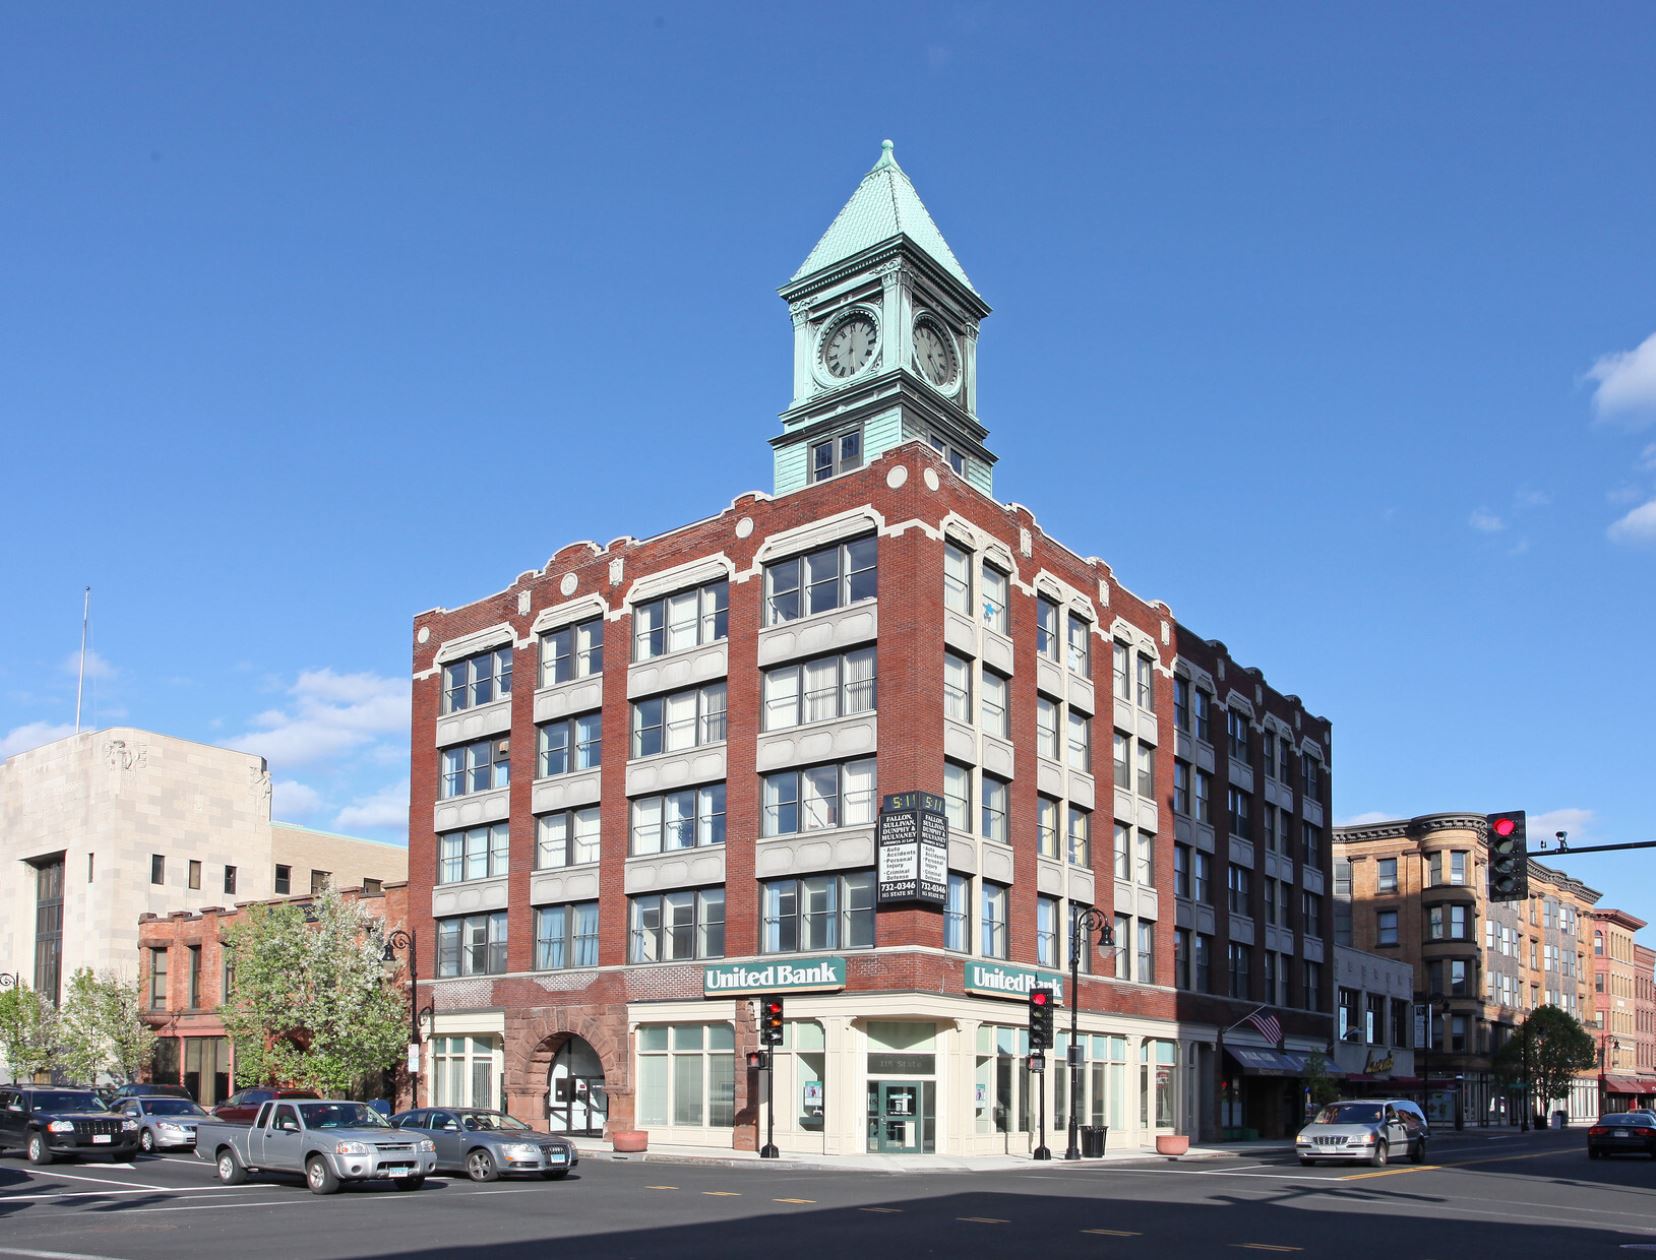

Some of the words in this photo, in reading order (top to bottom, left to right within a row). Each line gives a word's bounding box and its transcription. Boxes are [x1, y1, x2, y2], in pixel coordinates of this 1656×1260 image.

[881, 881, 916, 892] 732-0346
[921, 881, 946, 894] 732-0346
[706, 966, 775, 989] United
[776, 962, 838, 985] Bank
[973, 966, 1024, 992] United
